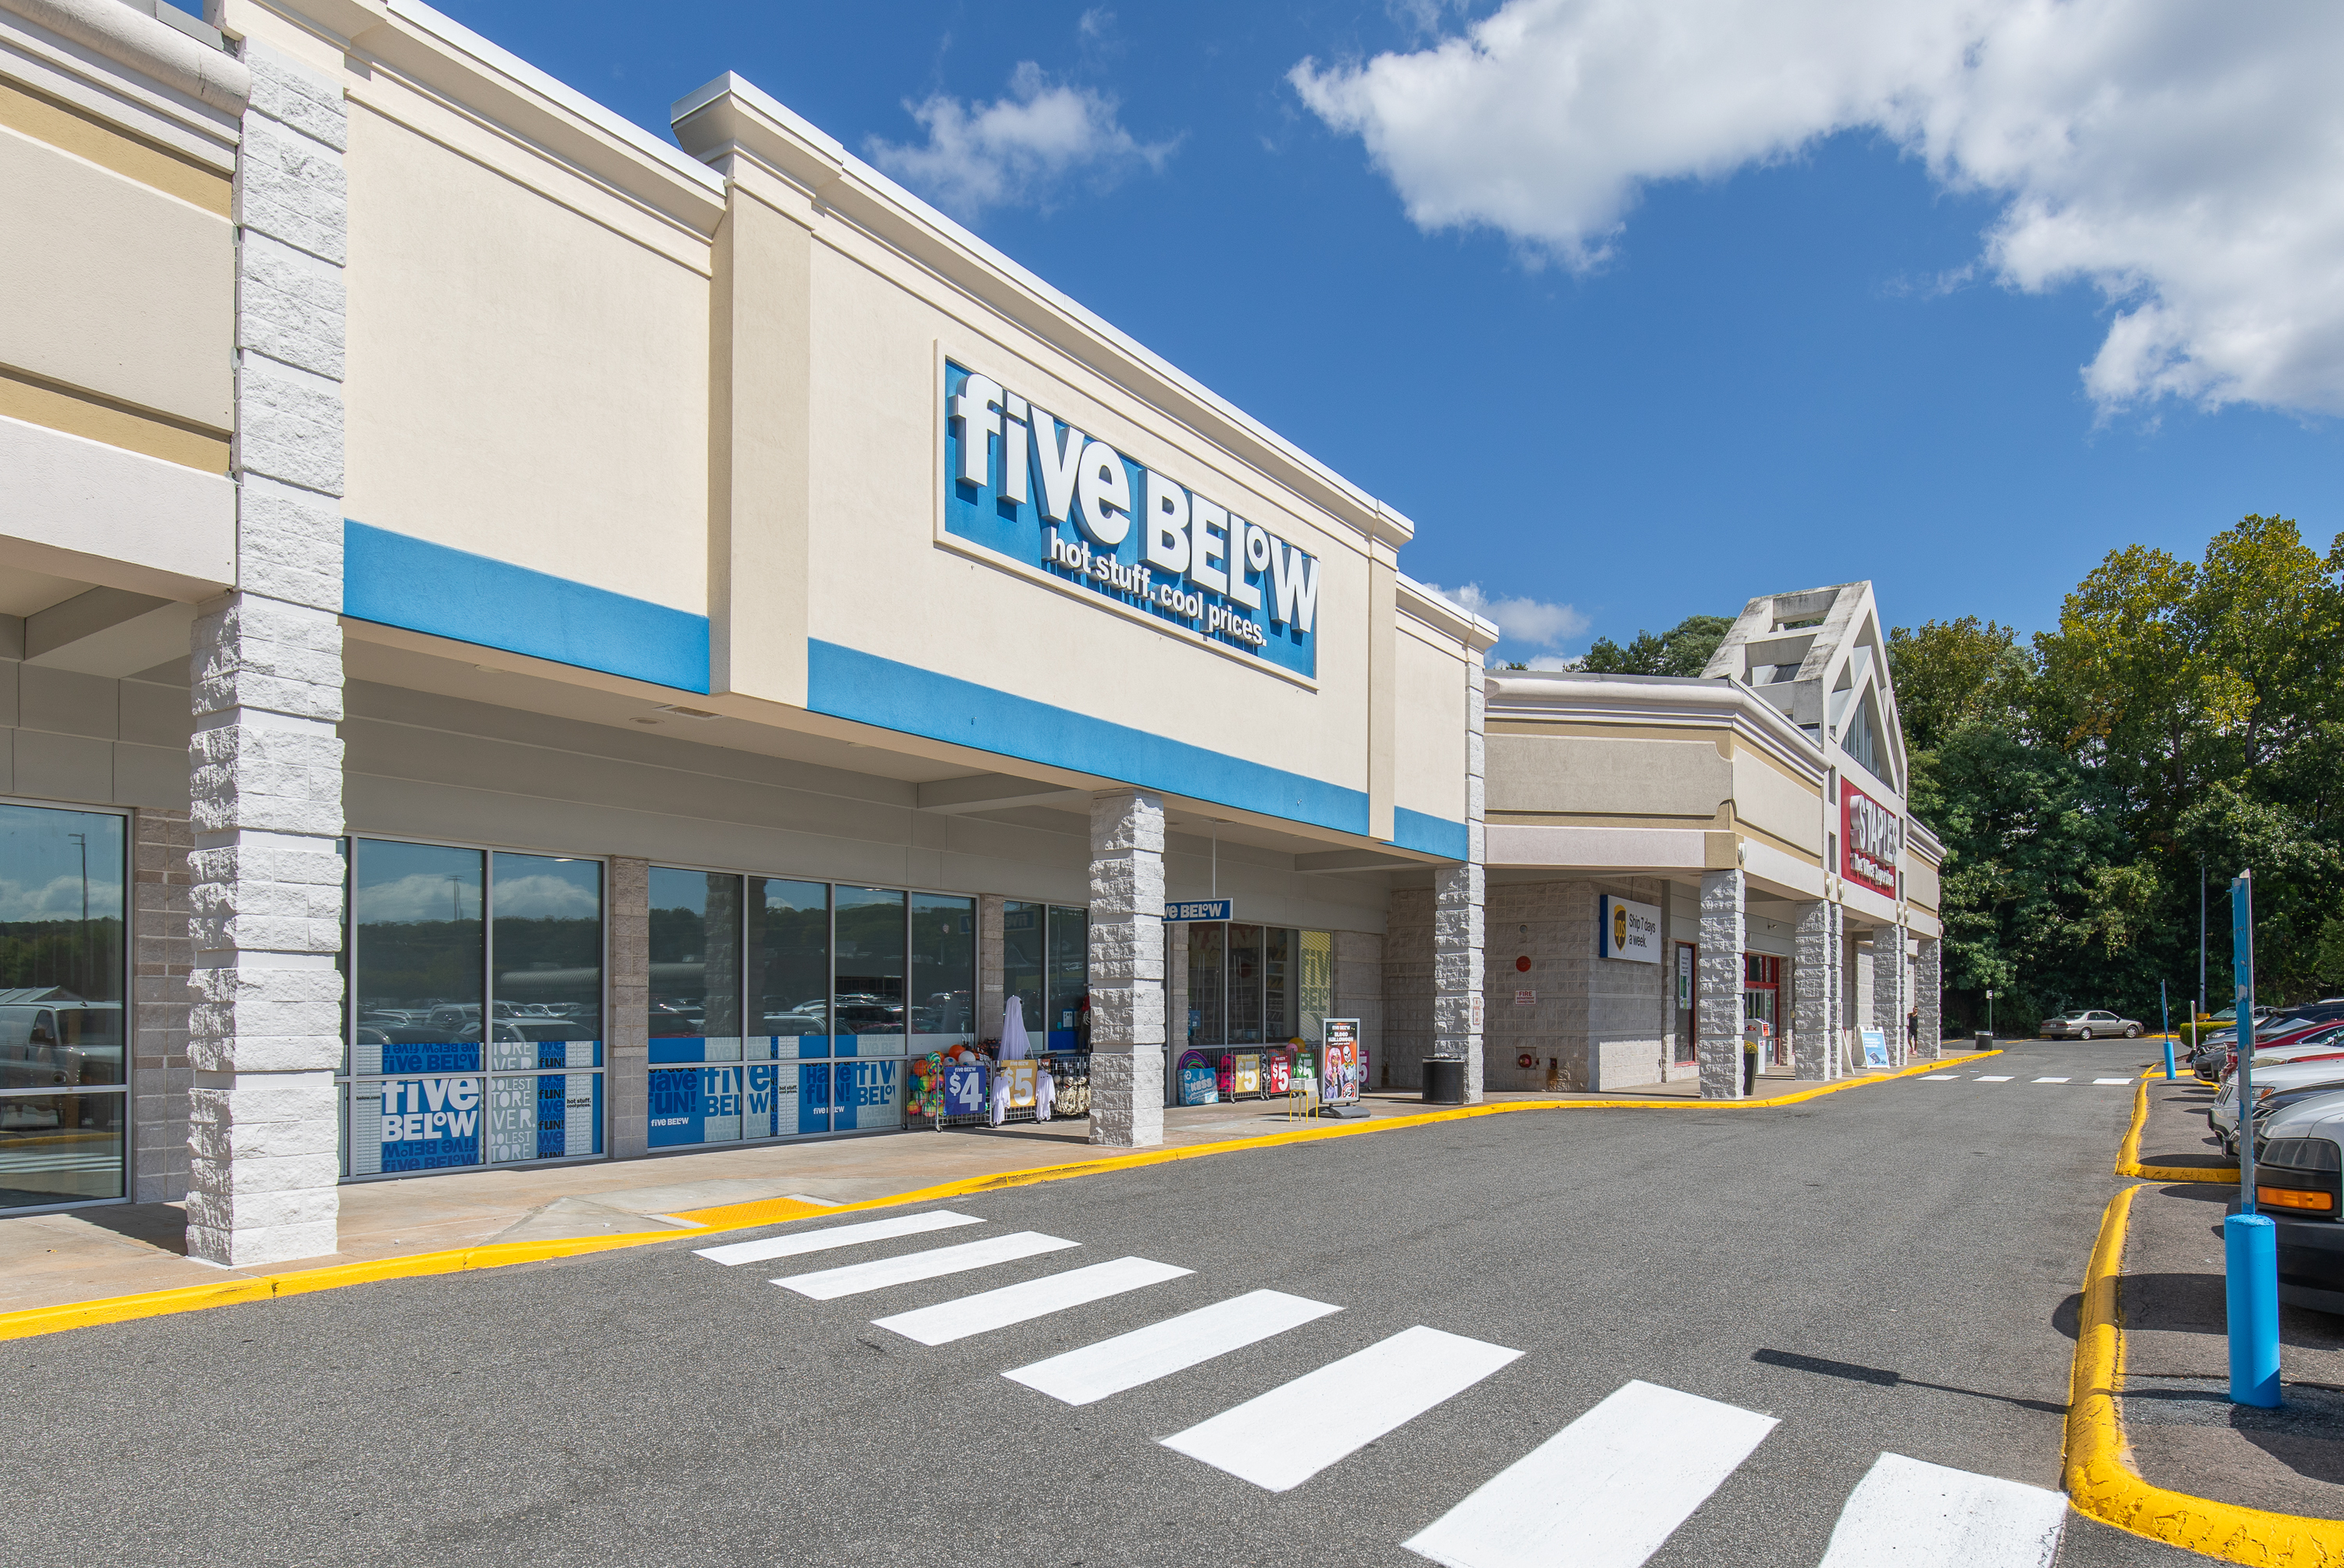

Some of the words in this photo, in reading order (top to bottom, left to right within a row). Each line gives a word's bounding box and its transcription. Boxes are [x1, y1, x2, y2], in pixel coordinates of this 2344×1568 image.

[948, 374, 1131, 545] five
[1046, 528, 1091, 573] hot
[1095, 552, 1155, 599] stuff.
[1160, 585, 1203, 620] cool
[1208, 604, 1267, 646] prices.
[1853, 795, 1898, 867] STAPLES
[1164, 905, 1177, 919] ve
[1629, 913, 1640, 932] Ship
[1641, 917, 1644, 930] 7
[1645, 918, 1656, 935] days
[1615, 920, 1625, 944] ups
[1629, 934, 1632, 945] a
[1301, 987, 1328, 1012] BELO
[857, 1061, 895, 1085] fiv
[1237, 1060, 1257, 1091] $5
[1273, 1062, 1288, 1091] $5
[1298, 1057, 1313, 1079] $5
[1359, 1056, 1367, 1083] 5
[381, 1078, 479, 1113] five
[857, 1085, 895, 1106] BELO
[949, 1072, 982, 1111] $4
[1004, 1067, 1033, 1105] $5
[1191, 1077, 1213, 1092] KESS
[705, 1092, 770, 1117] BELW
[381, 1110, 478, 1142] BELOW
[651, 1118, 666, 1127] five
